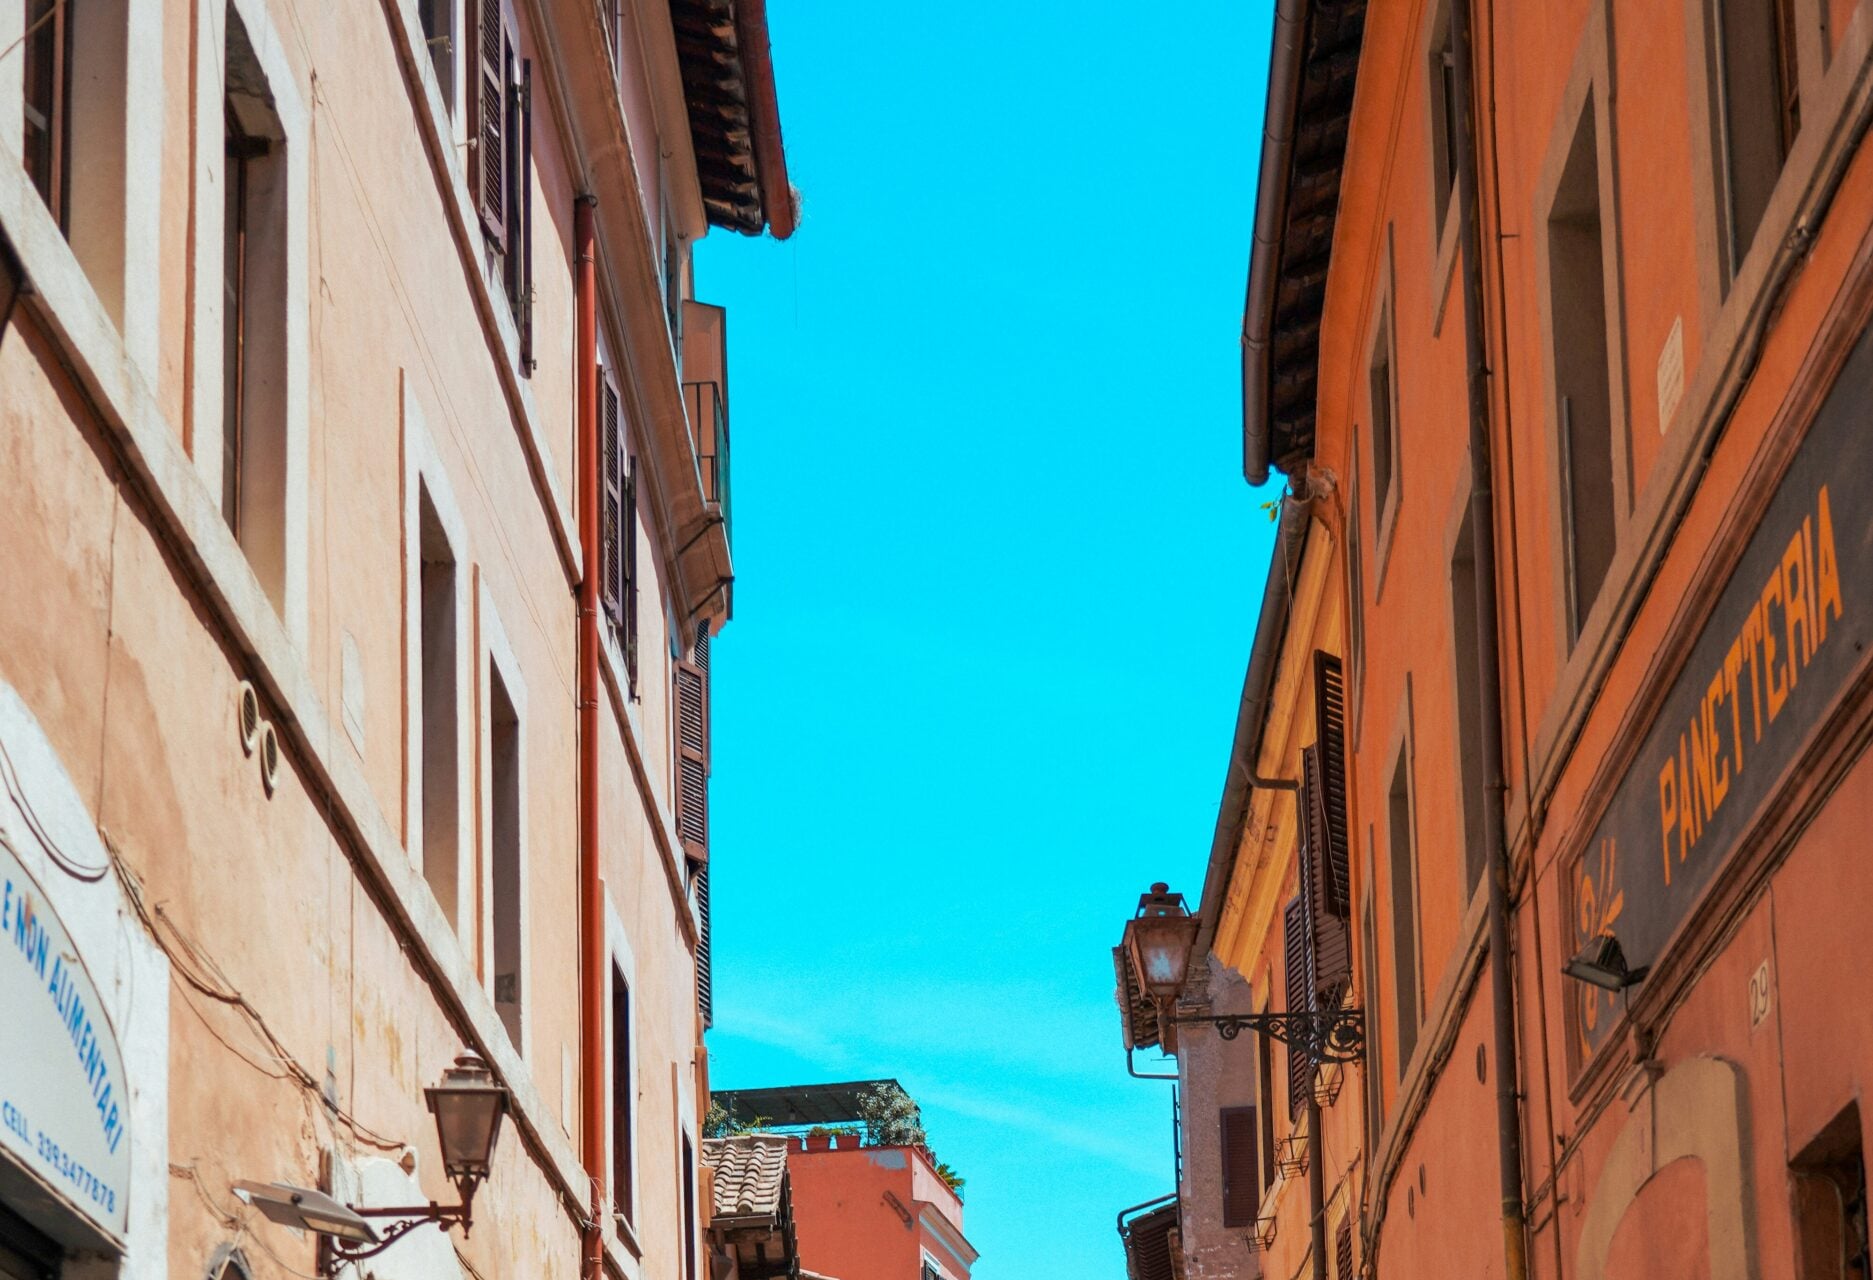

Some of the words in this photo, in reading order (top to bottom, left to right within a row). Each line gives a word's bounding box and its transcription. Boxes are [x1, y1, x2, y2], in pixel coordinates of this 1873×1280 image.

[1659, 484, 1843, 886] PANETTERIA
[3, 880, 13, 931] E
[14, 895, 51, 981] NON
[48, 954, 124, 1155] ALIMENTARI
[1750, 965, 1768, 1026] 29
